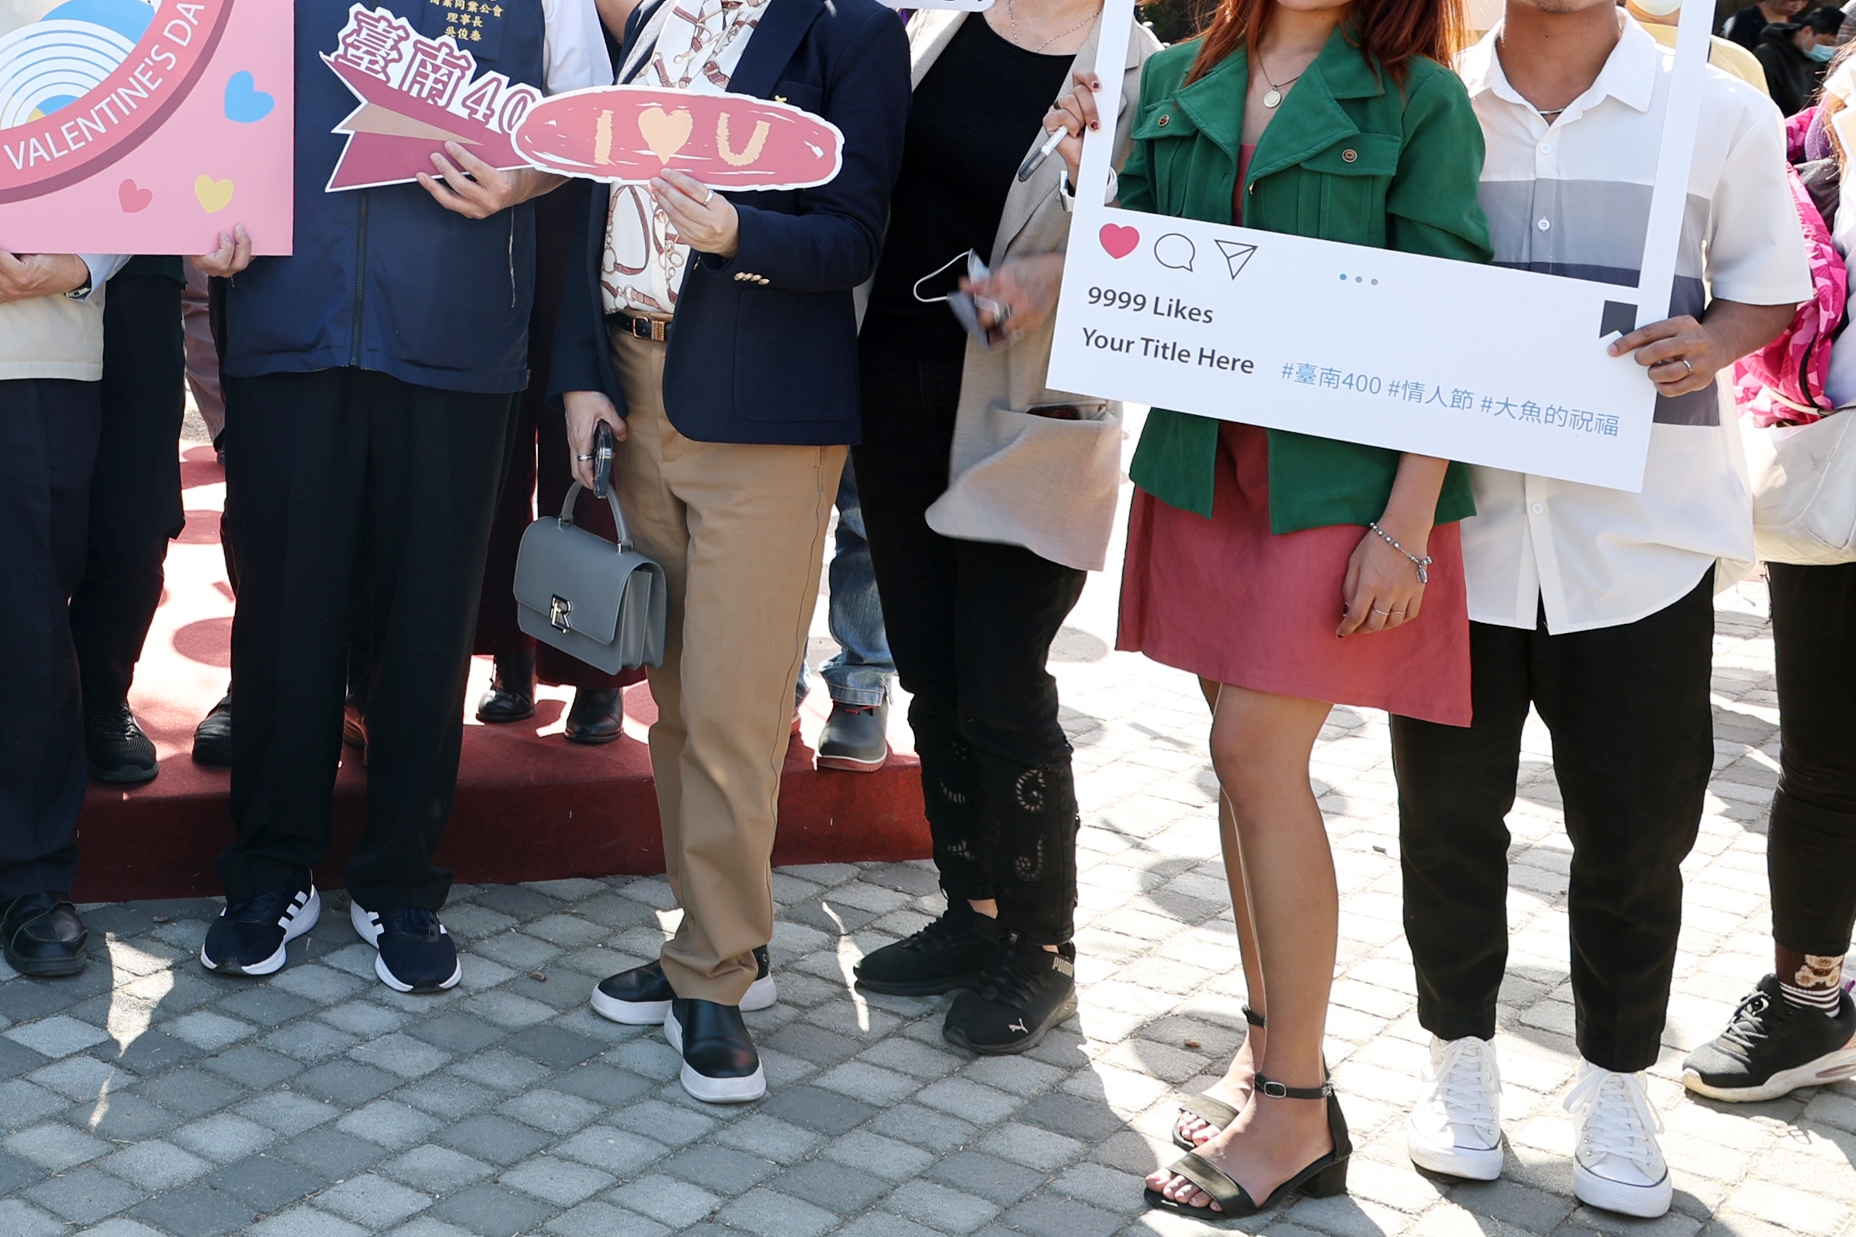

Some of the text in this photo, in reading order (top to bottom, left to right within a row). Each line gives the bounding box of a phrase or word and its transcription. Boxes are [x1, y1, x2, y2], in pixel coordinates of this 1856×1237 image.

[445, 11, 484, 28] 理事長
[2, 43, 178, 172] VALENTINE'S
[594, 109, 772, 167] I U
[1087, 286, 1215, 324] 9999 Likes
[1082, 327, 1255, 375] Your Title Here
[1280, 360, 1621, 437] #臺南400 #情人節 #大魚的祝福
